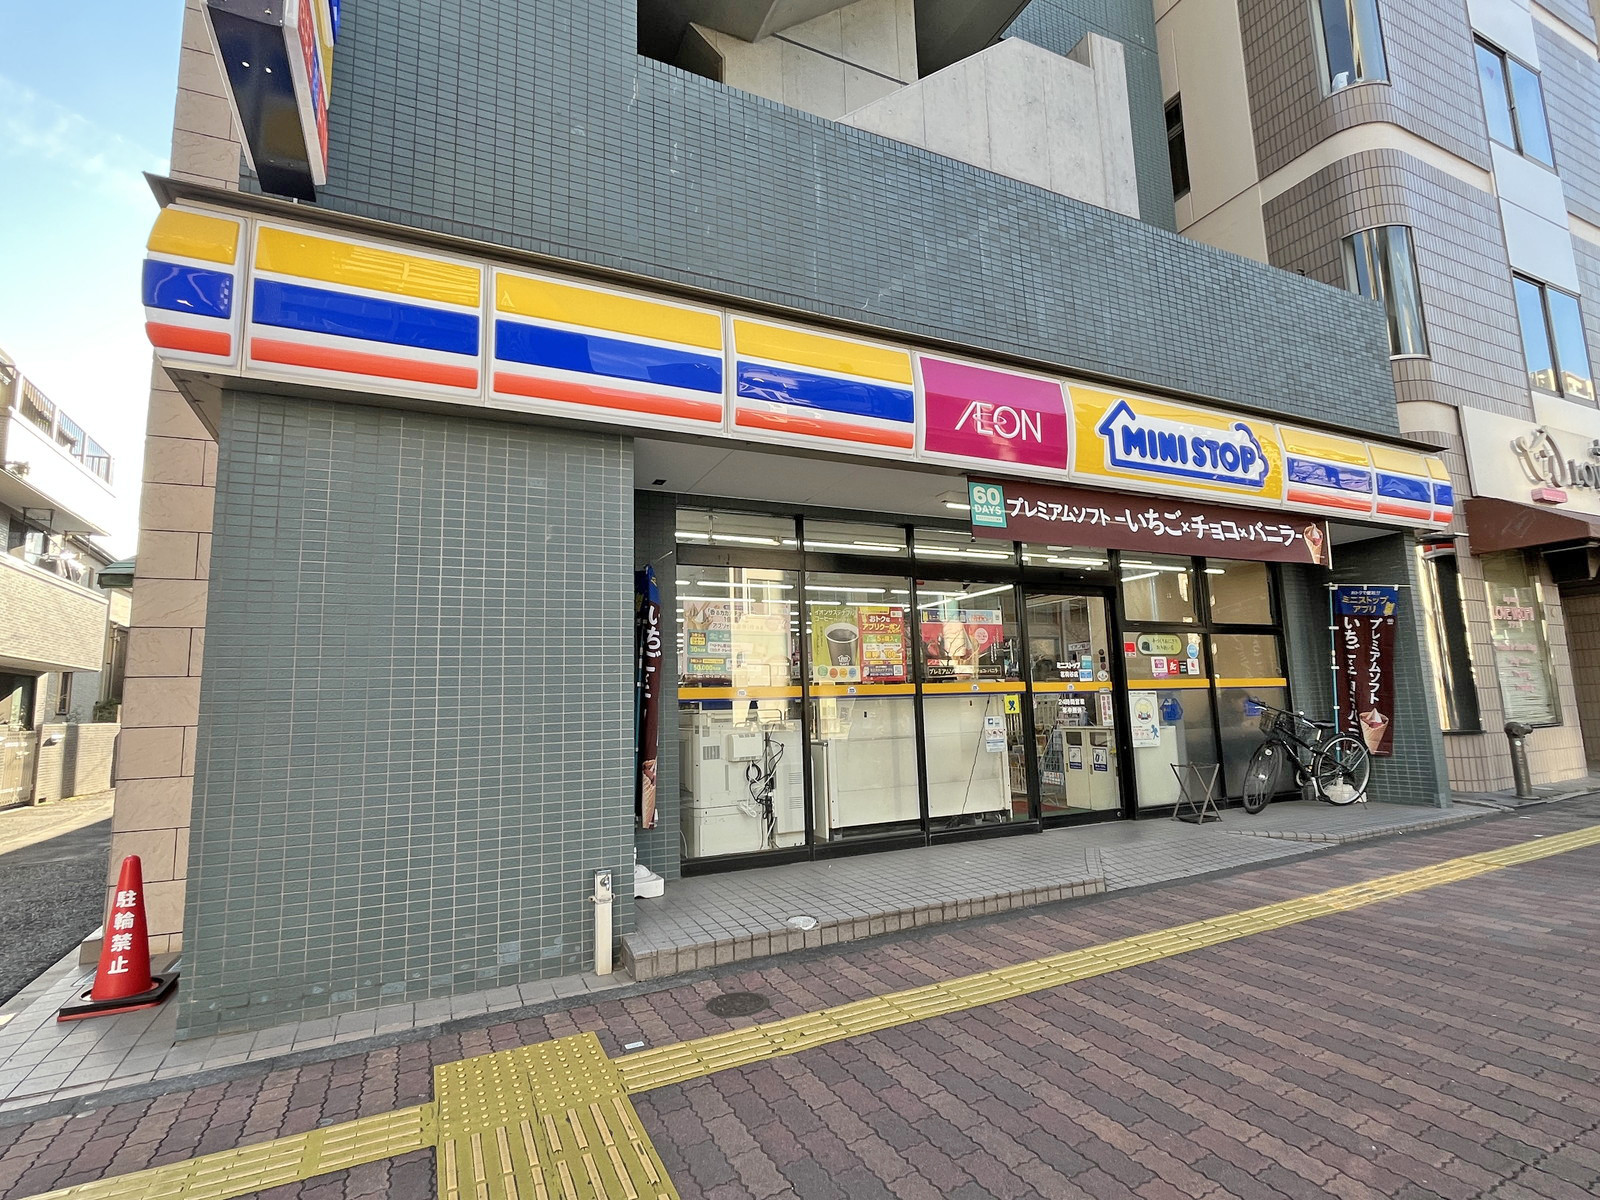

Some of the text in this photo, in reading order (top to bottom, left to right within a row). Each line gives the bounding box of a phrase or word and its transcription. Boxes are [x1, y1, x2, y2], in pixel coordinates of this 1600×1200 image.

[1122, 424, 1257, 474] MINI STOP
[972, 486, 1000, 505] 60
[974, 503, 1002, 515] DAYS
[1342, 596, 1389, 604] ミニストップ
[1352, 605, 1377, 613] アプリ
[1368, 617, 1384, 705] プレミアムソフト
[107, 889, 137, 975] 駐輪禁止
